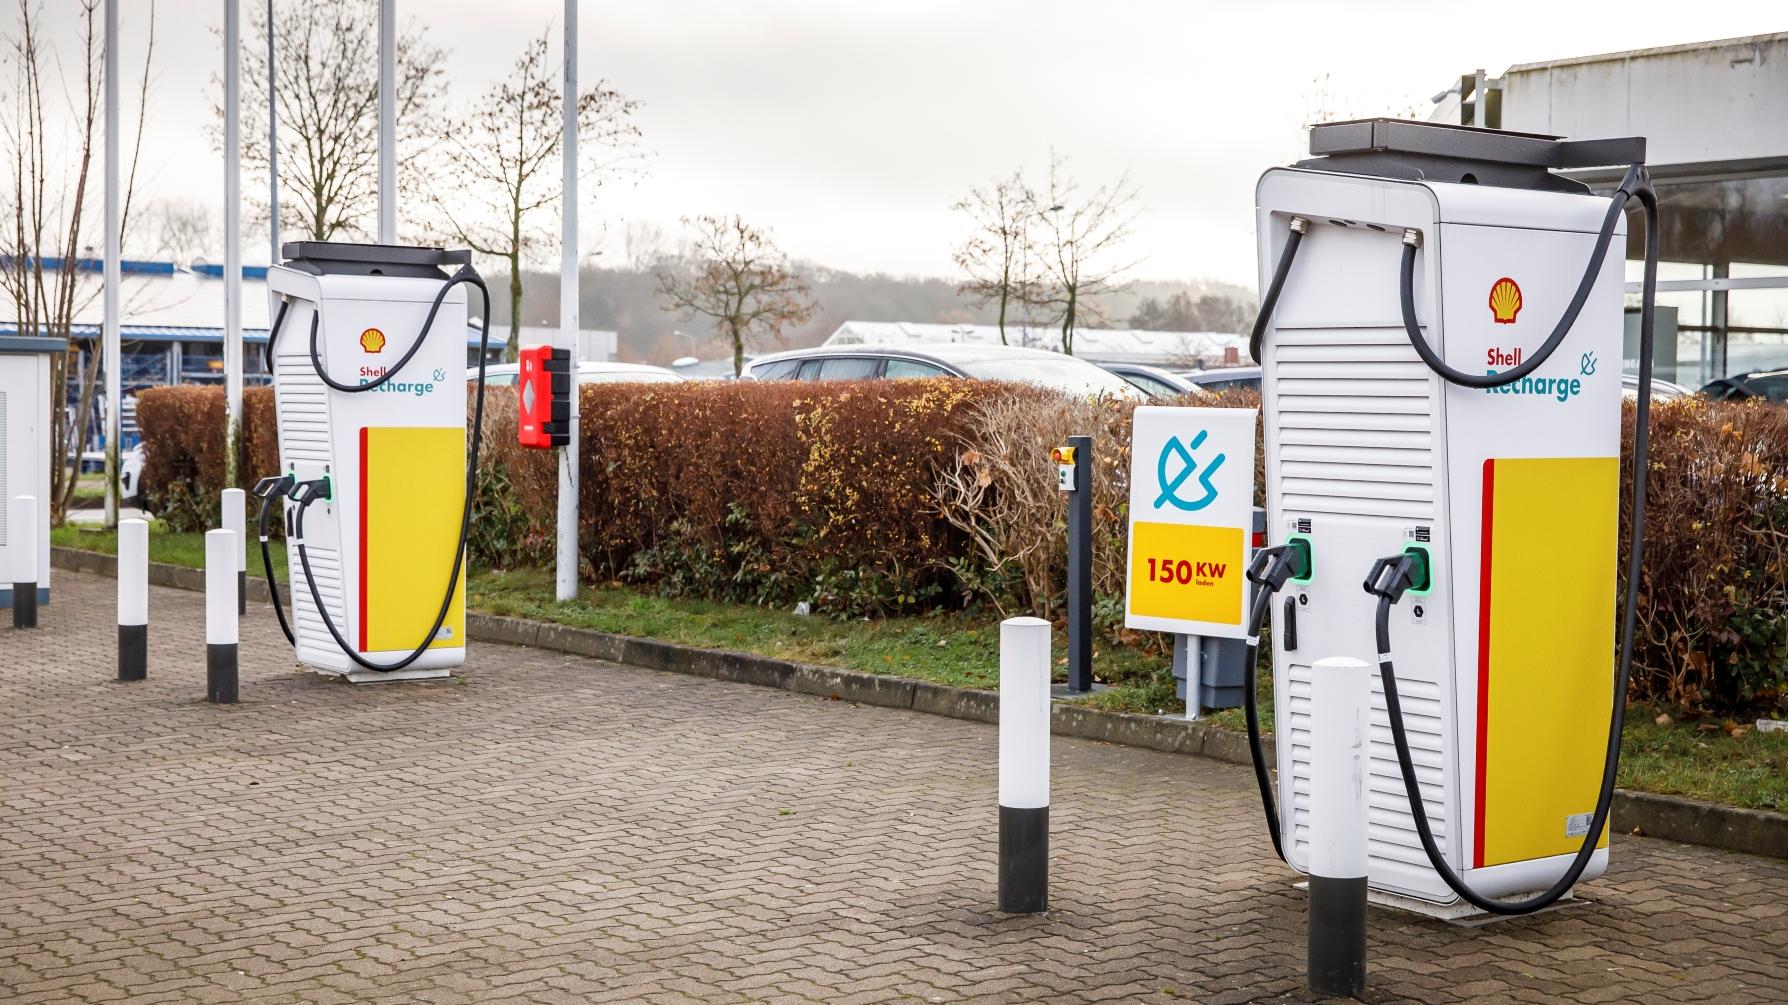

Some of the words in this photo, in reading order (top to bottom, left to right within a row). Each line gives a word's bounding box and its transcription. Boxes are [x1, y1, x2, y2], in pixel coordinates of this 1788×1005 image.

[1487, 347, 1521, 366] Shell
[360, 366, 386, 377] Shell
[1148, 558, 1192, 585] 150
[1196, 562, 1226, 578] KW
[1195, 579, 1214, 587] laden
